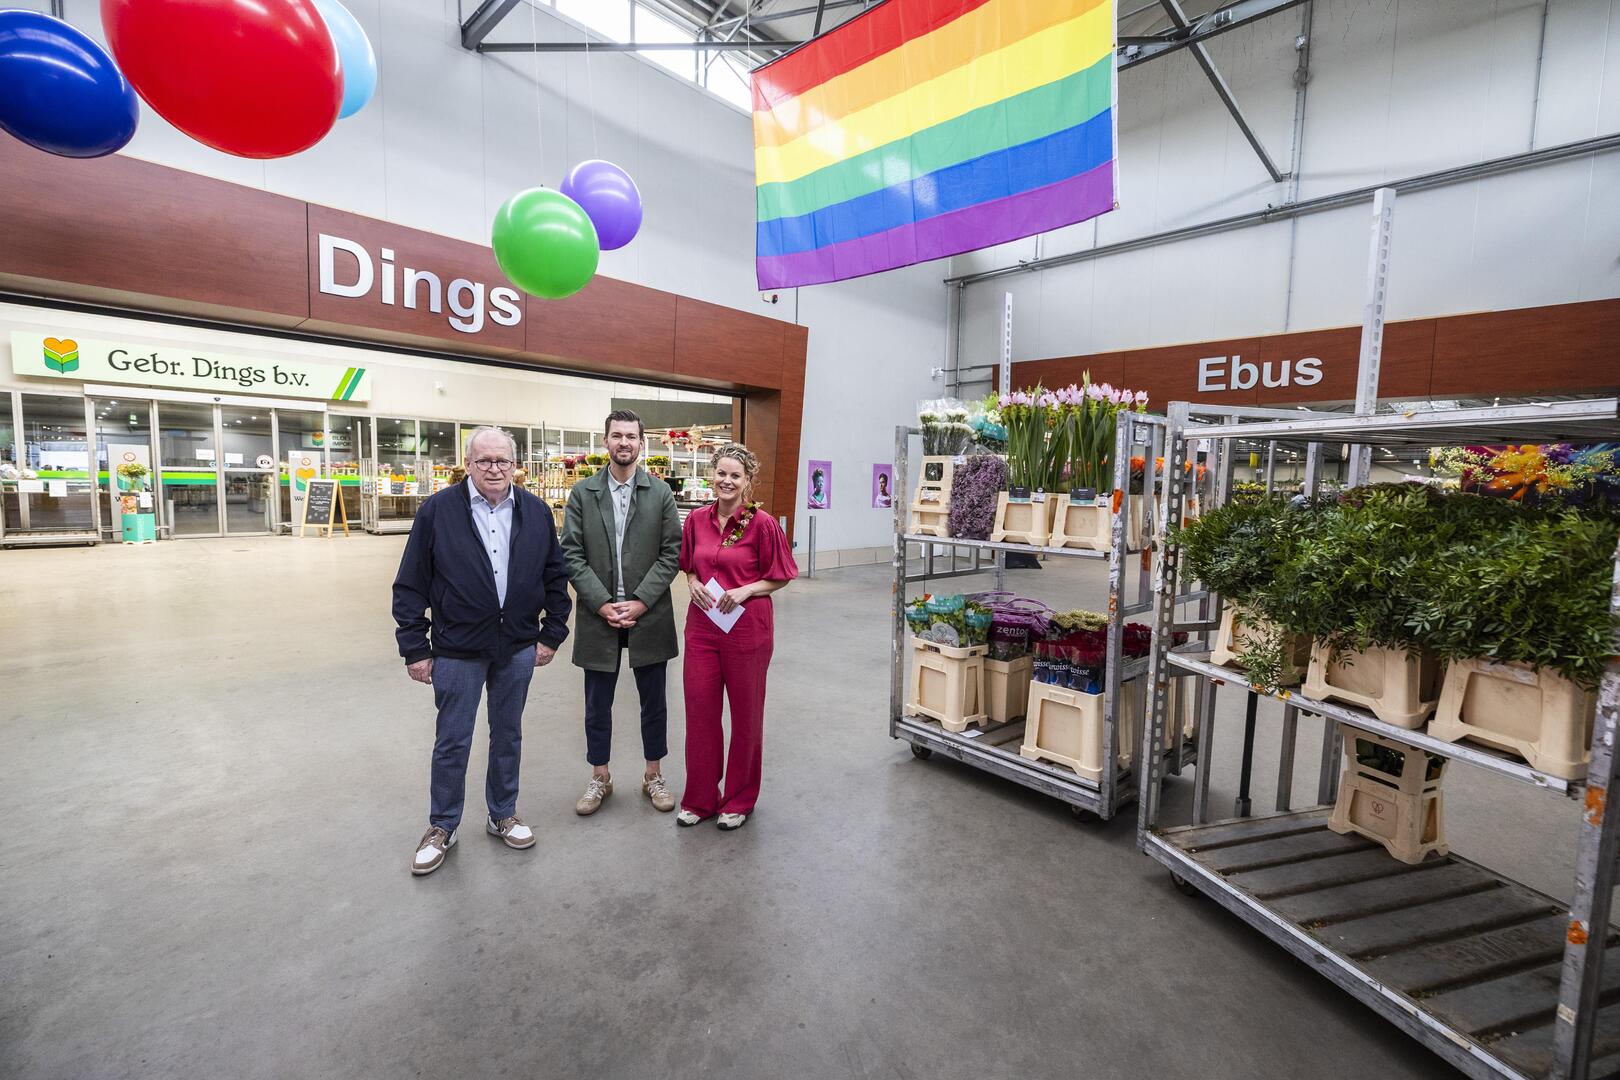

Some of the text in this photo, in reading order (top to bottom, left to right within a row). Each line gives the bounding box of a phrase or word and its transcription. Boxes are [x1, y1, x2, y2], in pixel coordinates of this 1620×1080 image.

[319, 233, 522, 333] Dings
[108, 349, 310, 387] Gebr. Dings b.v.
[1198, 355, 1323, 392] Ebus
